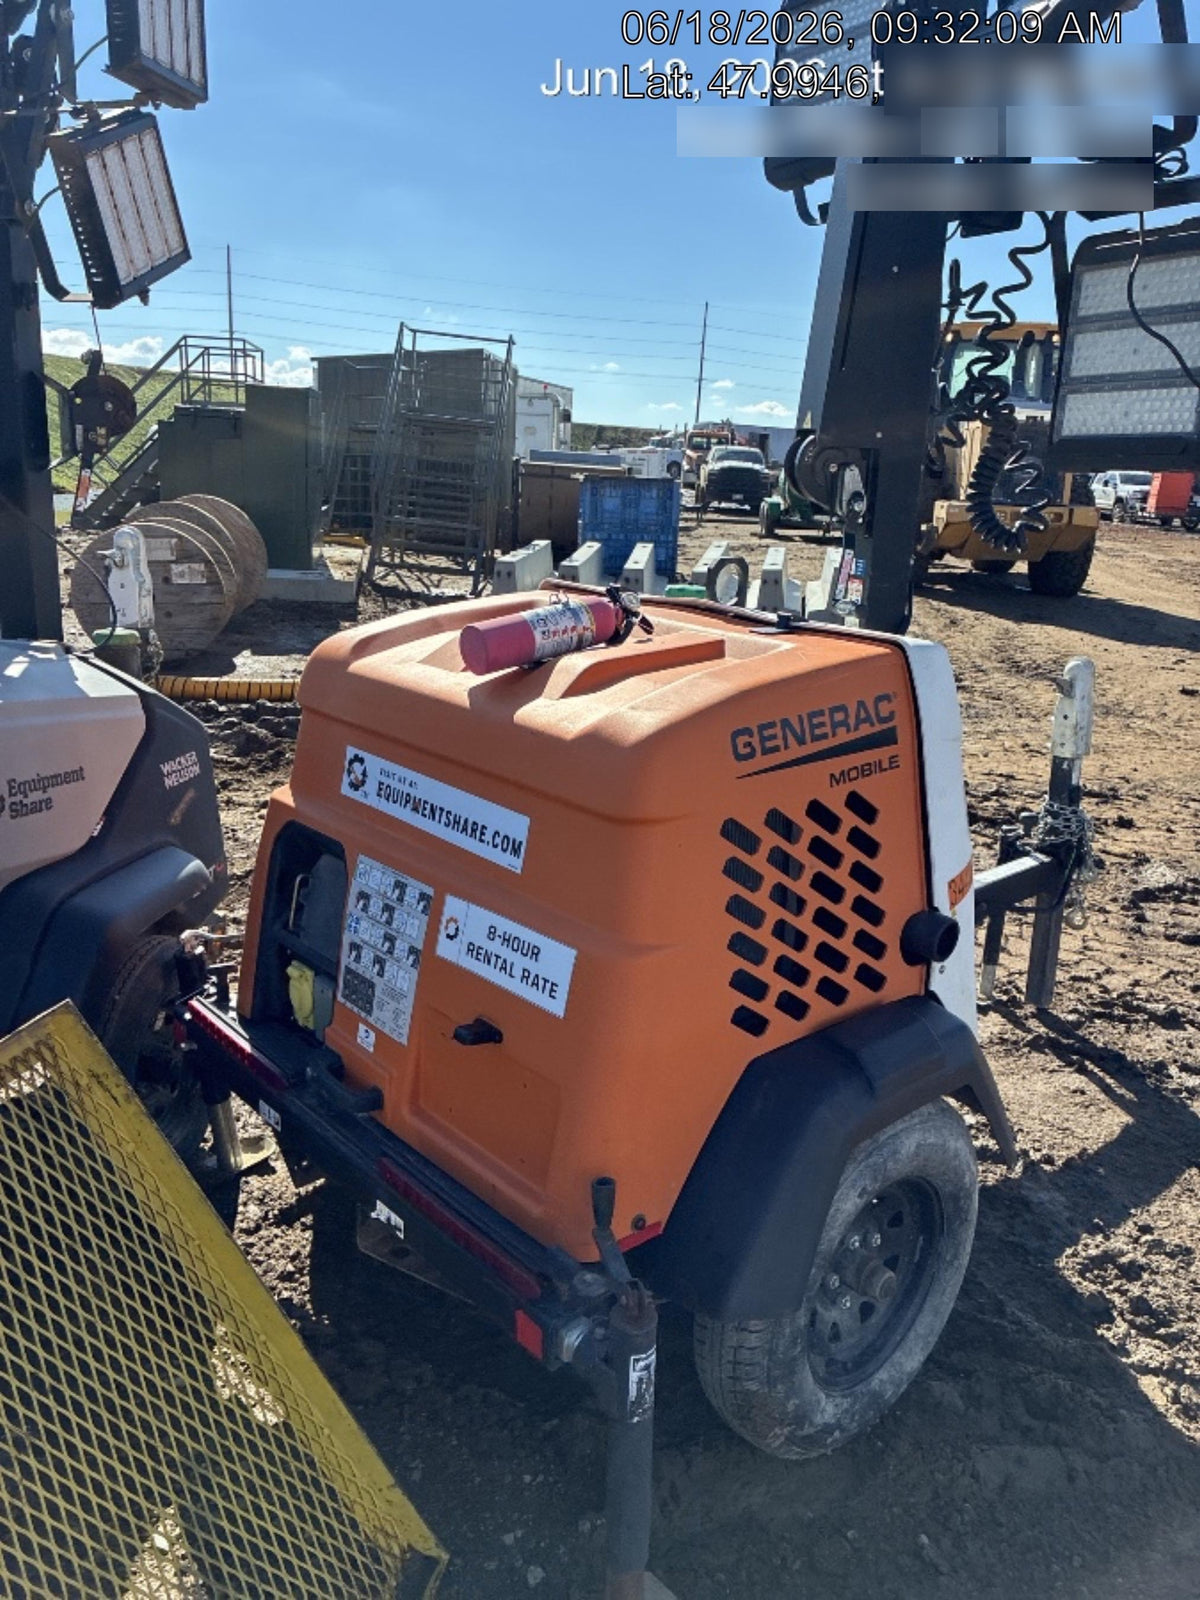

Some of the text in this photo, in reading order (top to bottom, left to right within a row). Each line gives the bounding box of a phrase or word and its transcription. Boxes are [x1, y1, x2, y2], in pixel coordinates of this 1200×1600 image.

[730, 693, 895, 762] GENERAC
[7, 766, 86, 799] Equipment
[829, 755, 900, 788] MOBILE
[9, 797, 53, 820] Share
[376, 780, 524, 859] EQUIPMENTSHARE.COM
[487, 925, 541, 963] 8-HOUR
[465, 941, 560, 1000] RENTAL RATE
